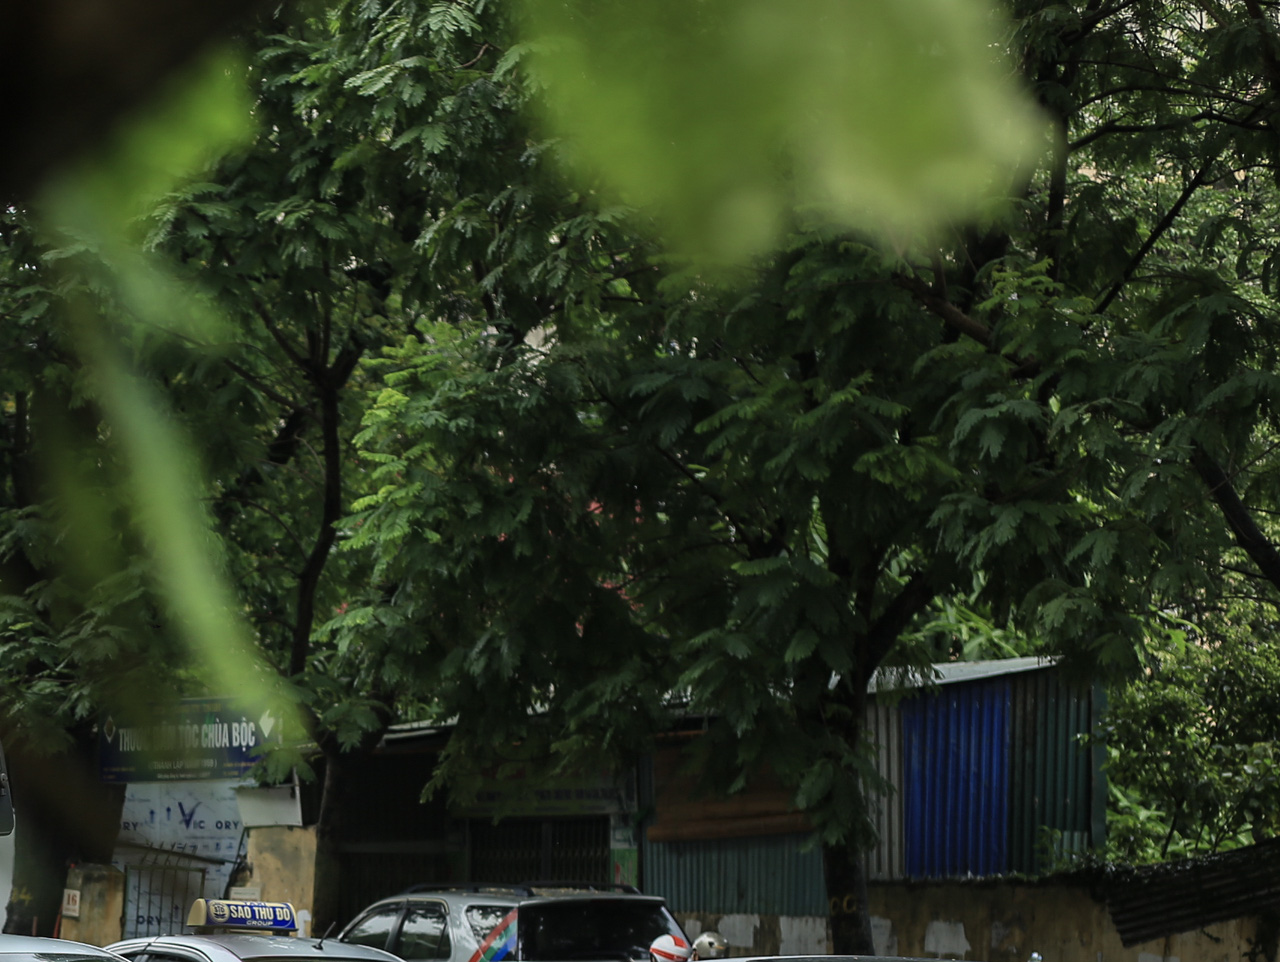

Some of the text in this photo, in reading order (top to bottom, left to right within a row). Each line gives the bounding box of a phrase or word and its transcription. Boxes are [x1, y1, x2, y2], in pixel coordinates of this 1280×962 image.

[201, 717, 230, 749] CHÙA
[232, 716, 256, 752] BỘC
[230, 905, 252, 919] SAO
